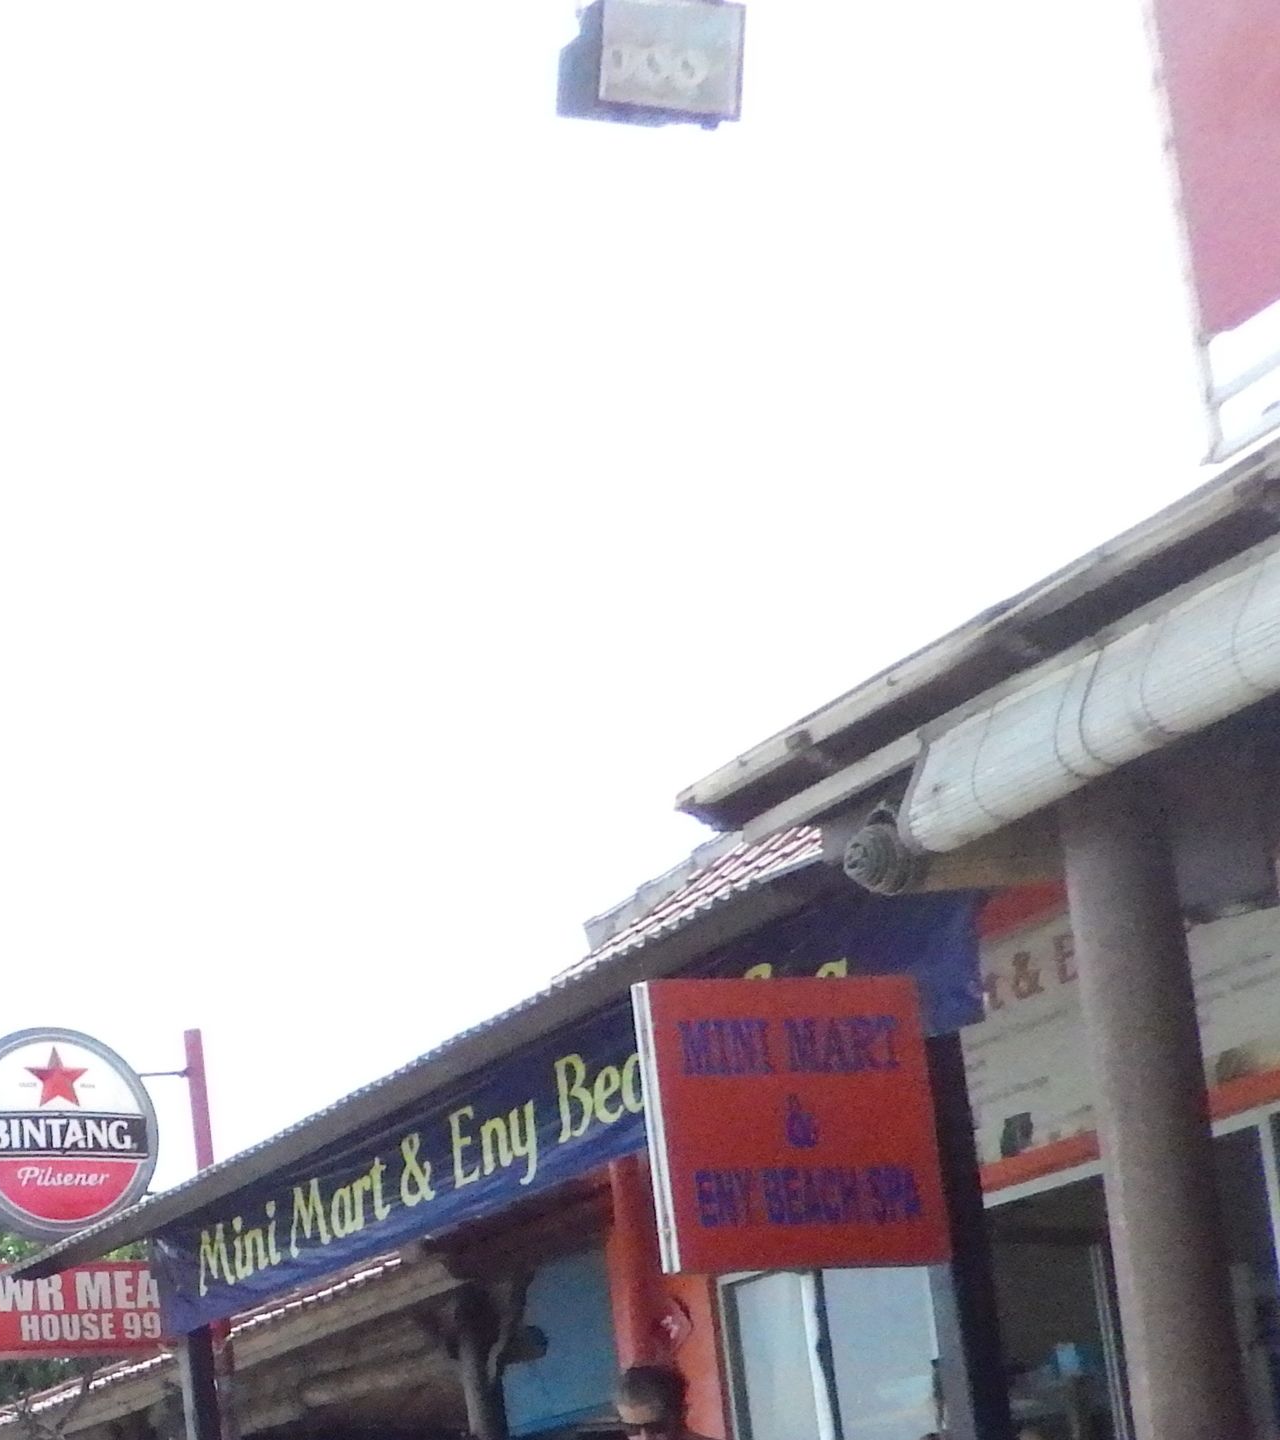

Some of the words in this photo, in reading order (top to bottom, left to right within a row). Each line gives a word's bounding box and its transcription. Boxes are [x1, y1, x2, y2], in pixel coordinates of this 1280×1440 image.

[677, 1017, 775, 1076] MINI
[782, 1014, 902, 1073] MART
[16, 1165, 110, 1188] Pilsener
[198, 1200, 282, 1297] Mini
[289, 1156, 392, 1258] Mart
[399, 1132, 436, 1208] &
[448, 1099, 538, 1186] Eny
[694, 1168, 754, 1228] ENY
[20, 1312, 117, 1342] HOUSE
[122, 1311, 162, 1339] 99
